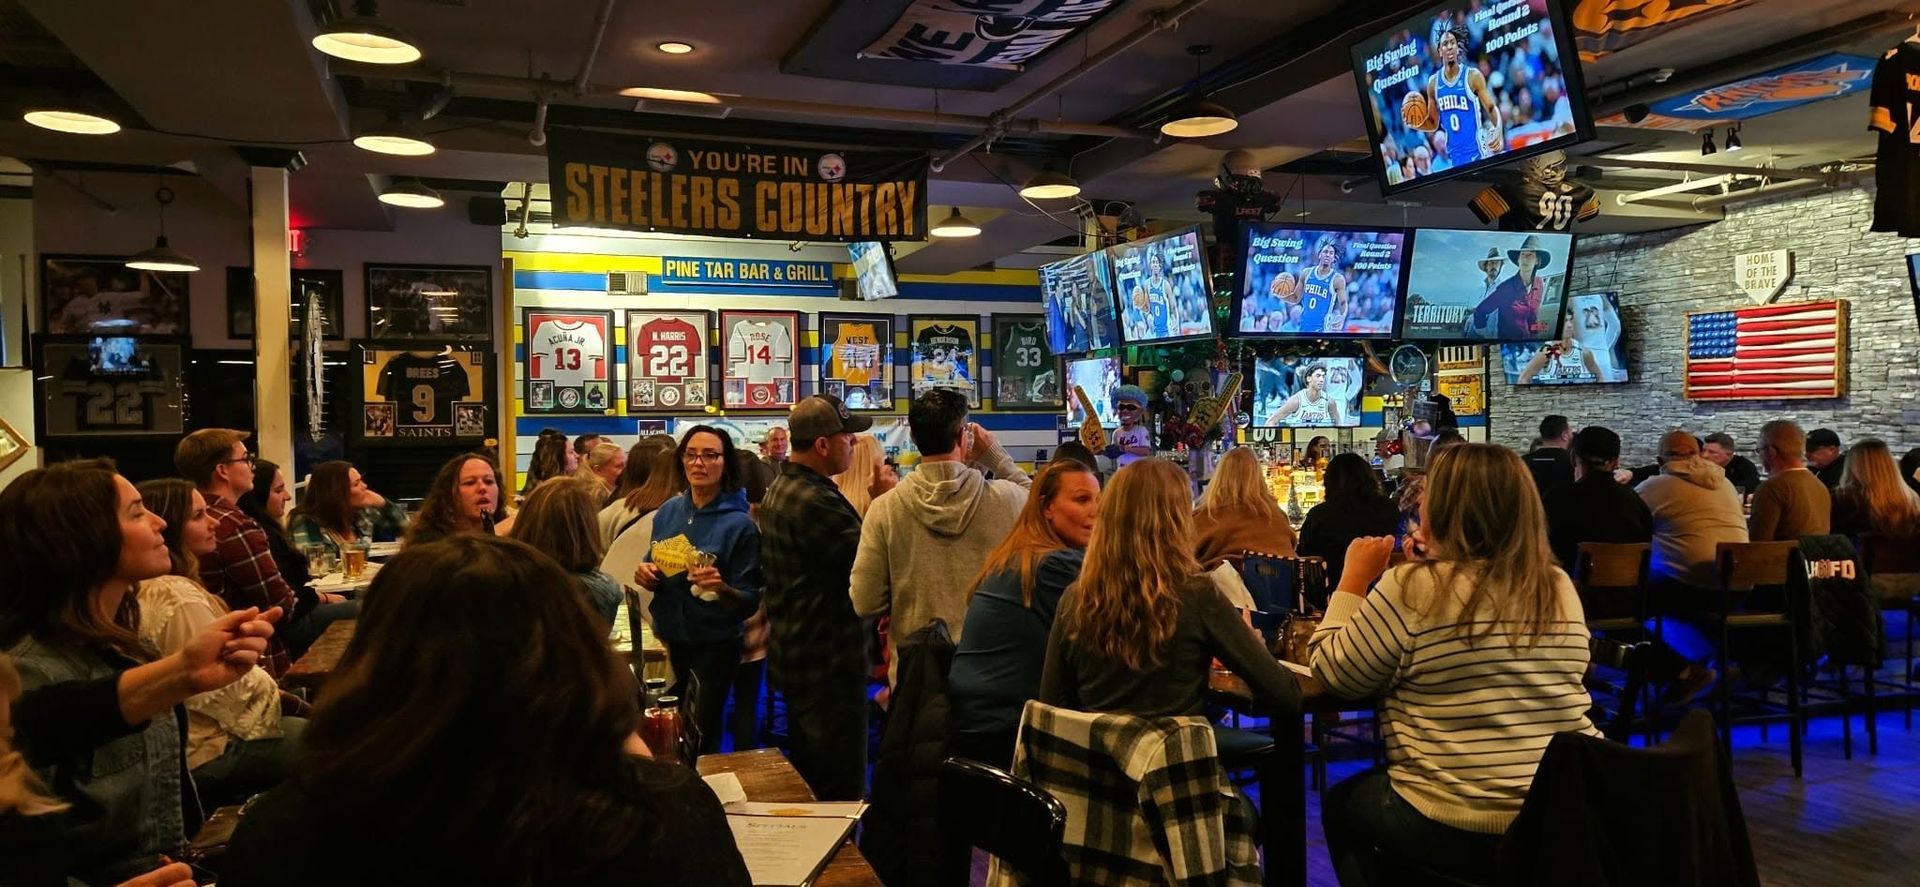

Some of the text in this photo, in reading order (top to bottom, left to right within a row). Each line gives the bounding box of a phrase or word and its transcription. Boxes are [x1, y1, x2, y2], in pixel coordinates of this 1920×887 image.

[1474, 5, 1496, 22] Final
[1488, 4, 1531, 31] Round 2
[1485, 23, 1539, 54] 100 Points
[1366, 39, 1417, 73] Big Swing
[1373, 64, 1419, 94] Question
[1438, 95, 1468, 112] PHILA
[1450, 114, 1459, 132] 0
[688, 149, 808, 177] YOU'RE IN
[565, 161, 916, 236] STEELERS COUNTRY
[1536, 191, 1573, 230] 90
[1253, 237, 1303, 249] Big Swing
[1253, 253, 1299, 264] Question
[1360, 250, 1385, 258] Round
[1746, 252, 1775, 265] HOME
[666, 261, 829, 282] PINE TAR BAR & GRILL
[1354, 262, 1392, 271] 100 Points
[1746, 265, 1777, 278] OF THE
[1304, 283, 1328, 298] PHILA
[1745, 278, 1777, 290] BRAVE
[1308, 297, 1316, 309] 0
[1412, 304, 1467, 324] TERRITORY
[548, 331, 573, 347] ACUÑA
[661, 330, 686, 341] HARRIS
[750, 333, 772, 343] ROSE
[846, 336, 869, 345] WEST
[1021, 336, 1036, 346] BIRD
[555, 347, 581, 370] 13
[650, 345, 688, 376] 22
[747, 345, 772, 366] 14
[1016, 348, 1042, 367] 33
[406, 367, 439, 379] BREES
[86, 382, 144, 425] 22
[412, 384, 435, 423] 9
[399, 427, 451, 438] SAINTS
[1118, 435, 1138, 445] Mets
